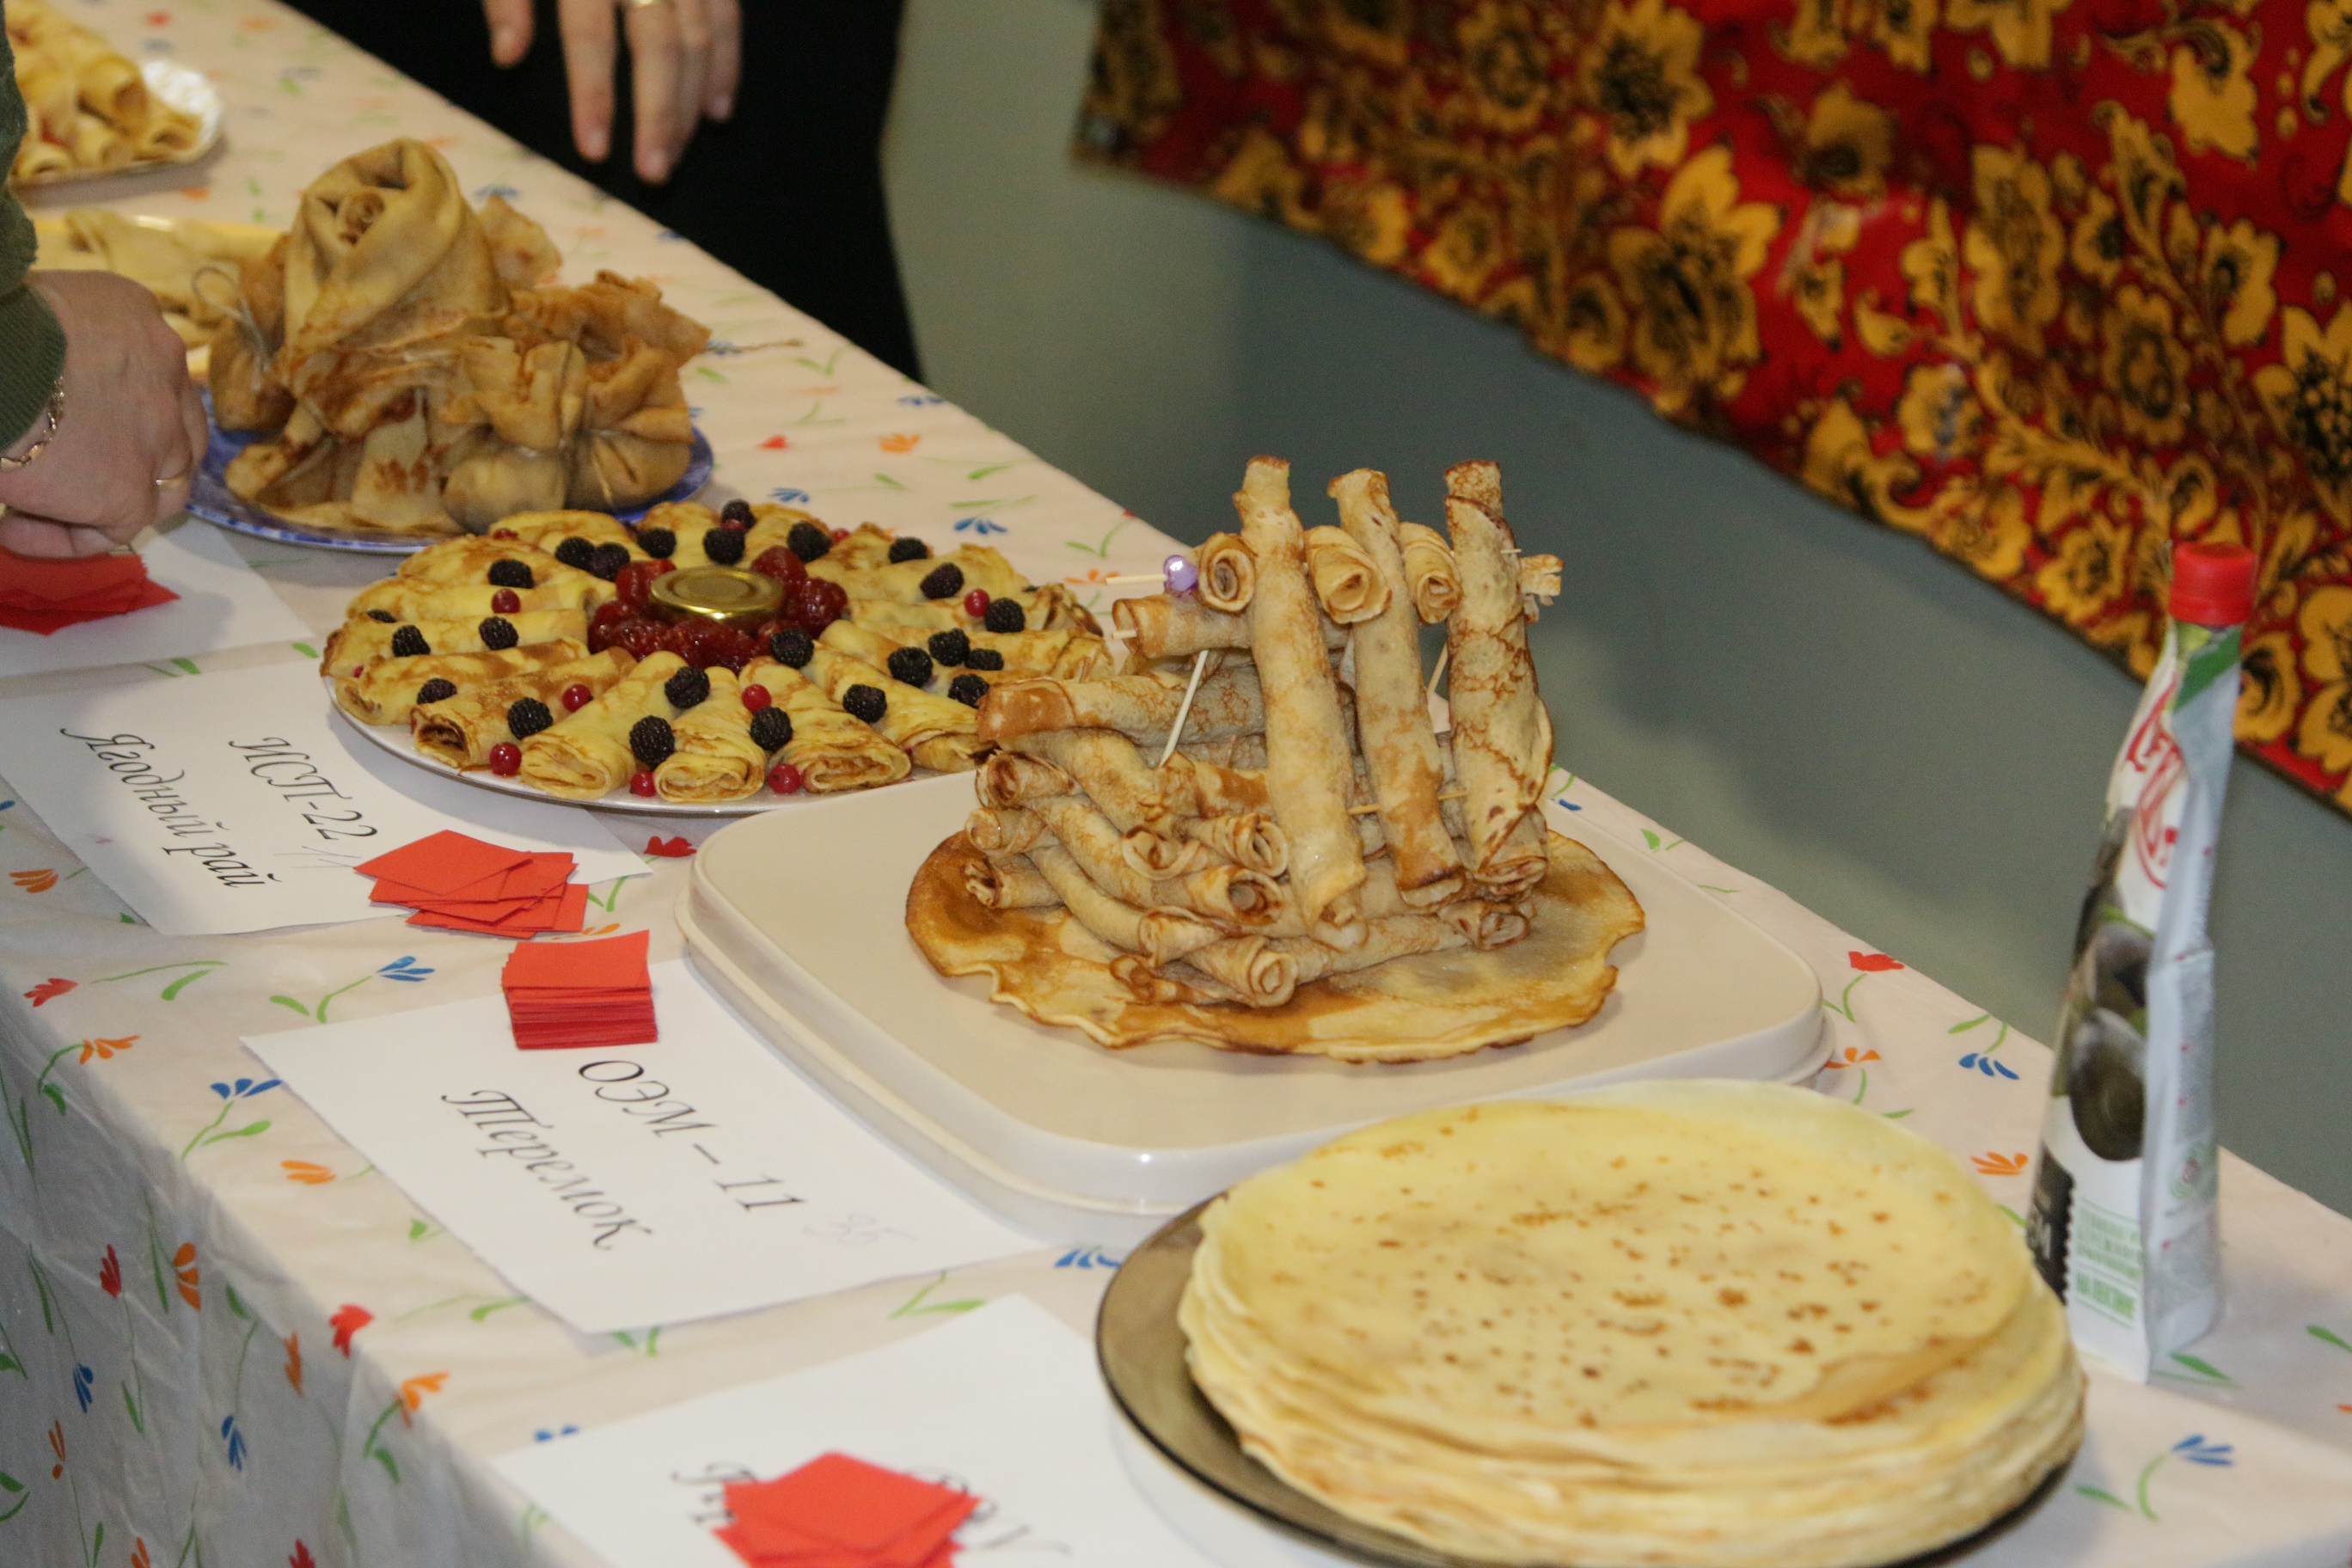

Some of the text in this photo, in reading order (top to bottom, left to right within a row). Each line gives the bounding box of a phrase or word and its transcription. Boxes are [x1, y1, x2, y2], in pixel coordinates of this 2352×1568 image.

[59, 727, 283, 888] Ягодный рай
[440, 1090, 654, 1252] Теремок
[578, 1059, 719, 1139] ОЭМ
[714, 1174, 807, 1212] 11
